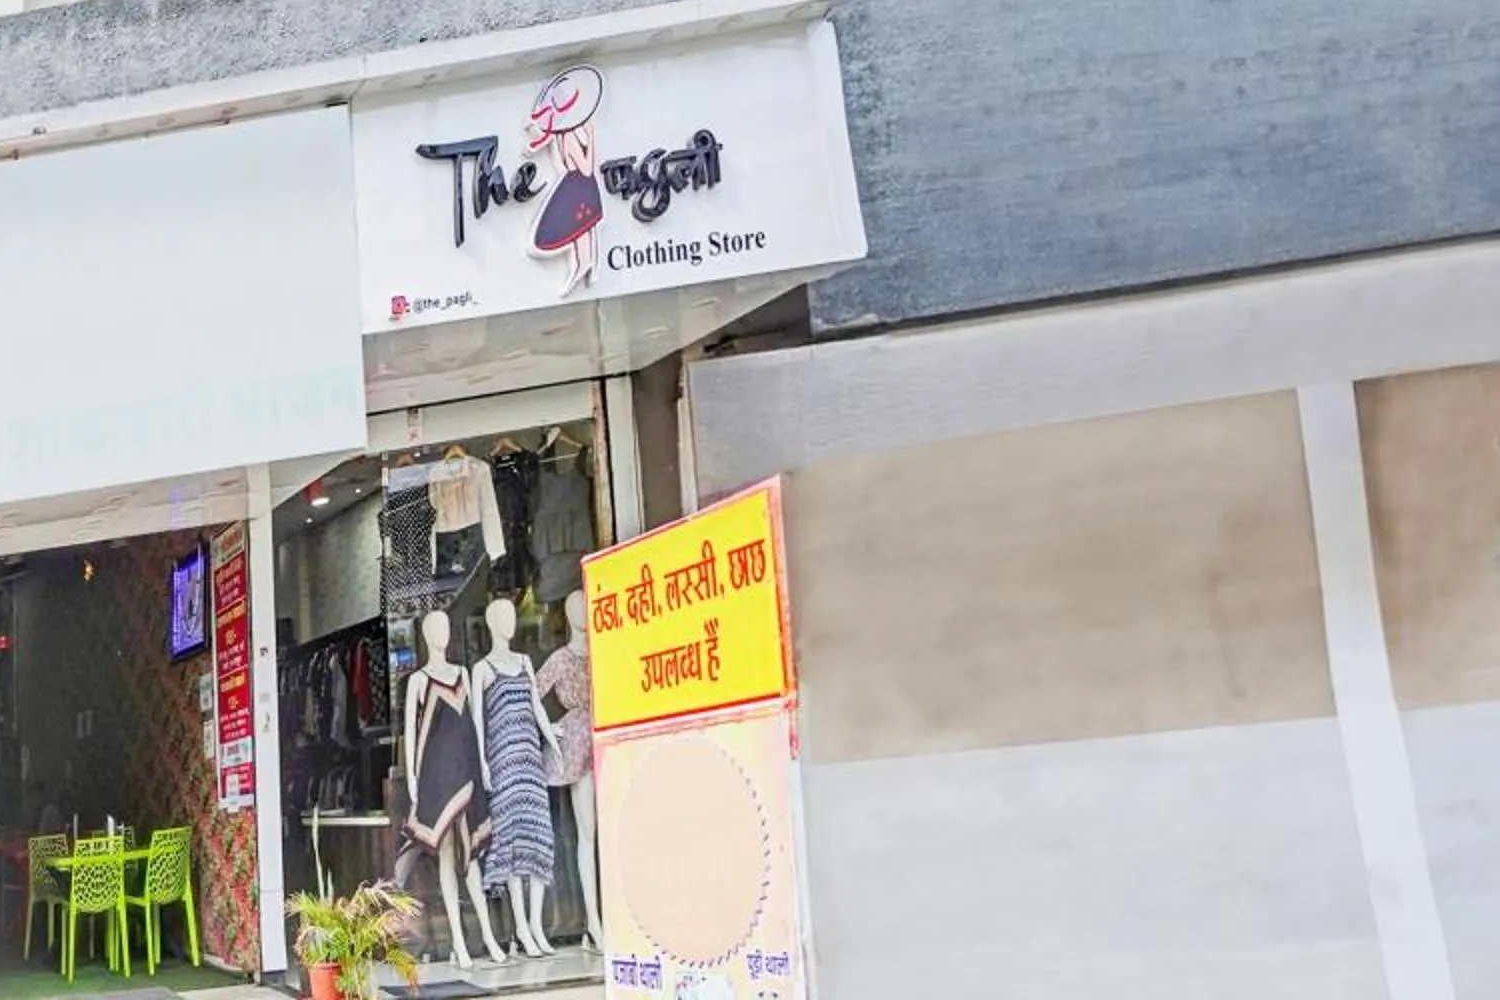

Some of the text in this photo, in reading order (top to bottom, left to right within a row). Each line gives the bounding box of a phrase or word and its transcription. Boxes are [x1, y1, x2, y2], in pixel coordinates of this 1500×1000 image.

[415, 135, 546, 248] The
[607, 229, 767, 272] Clothing Store
